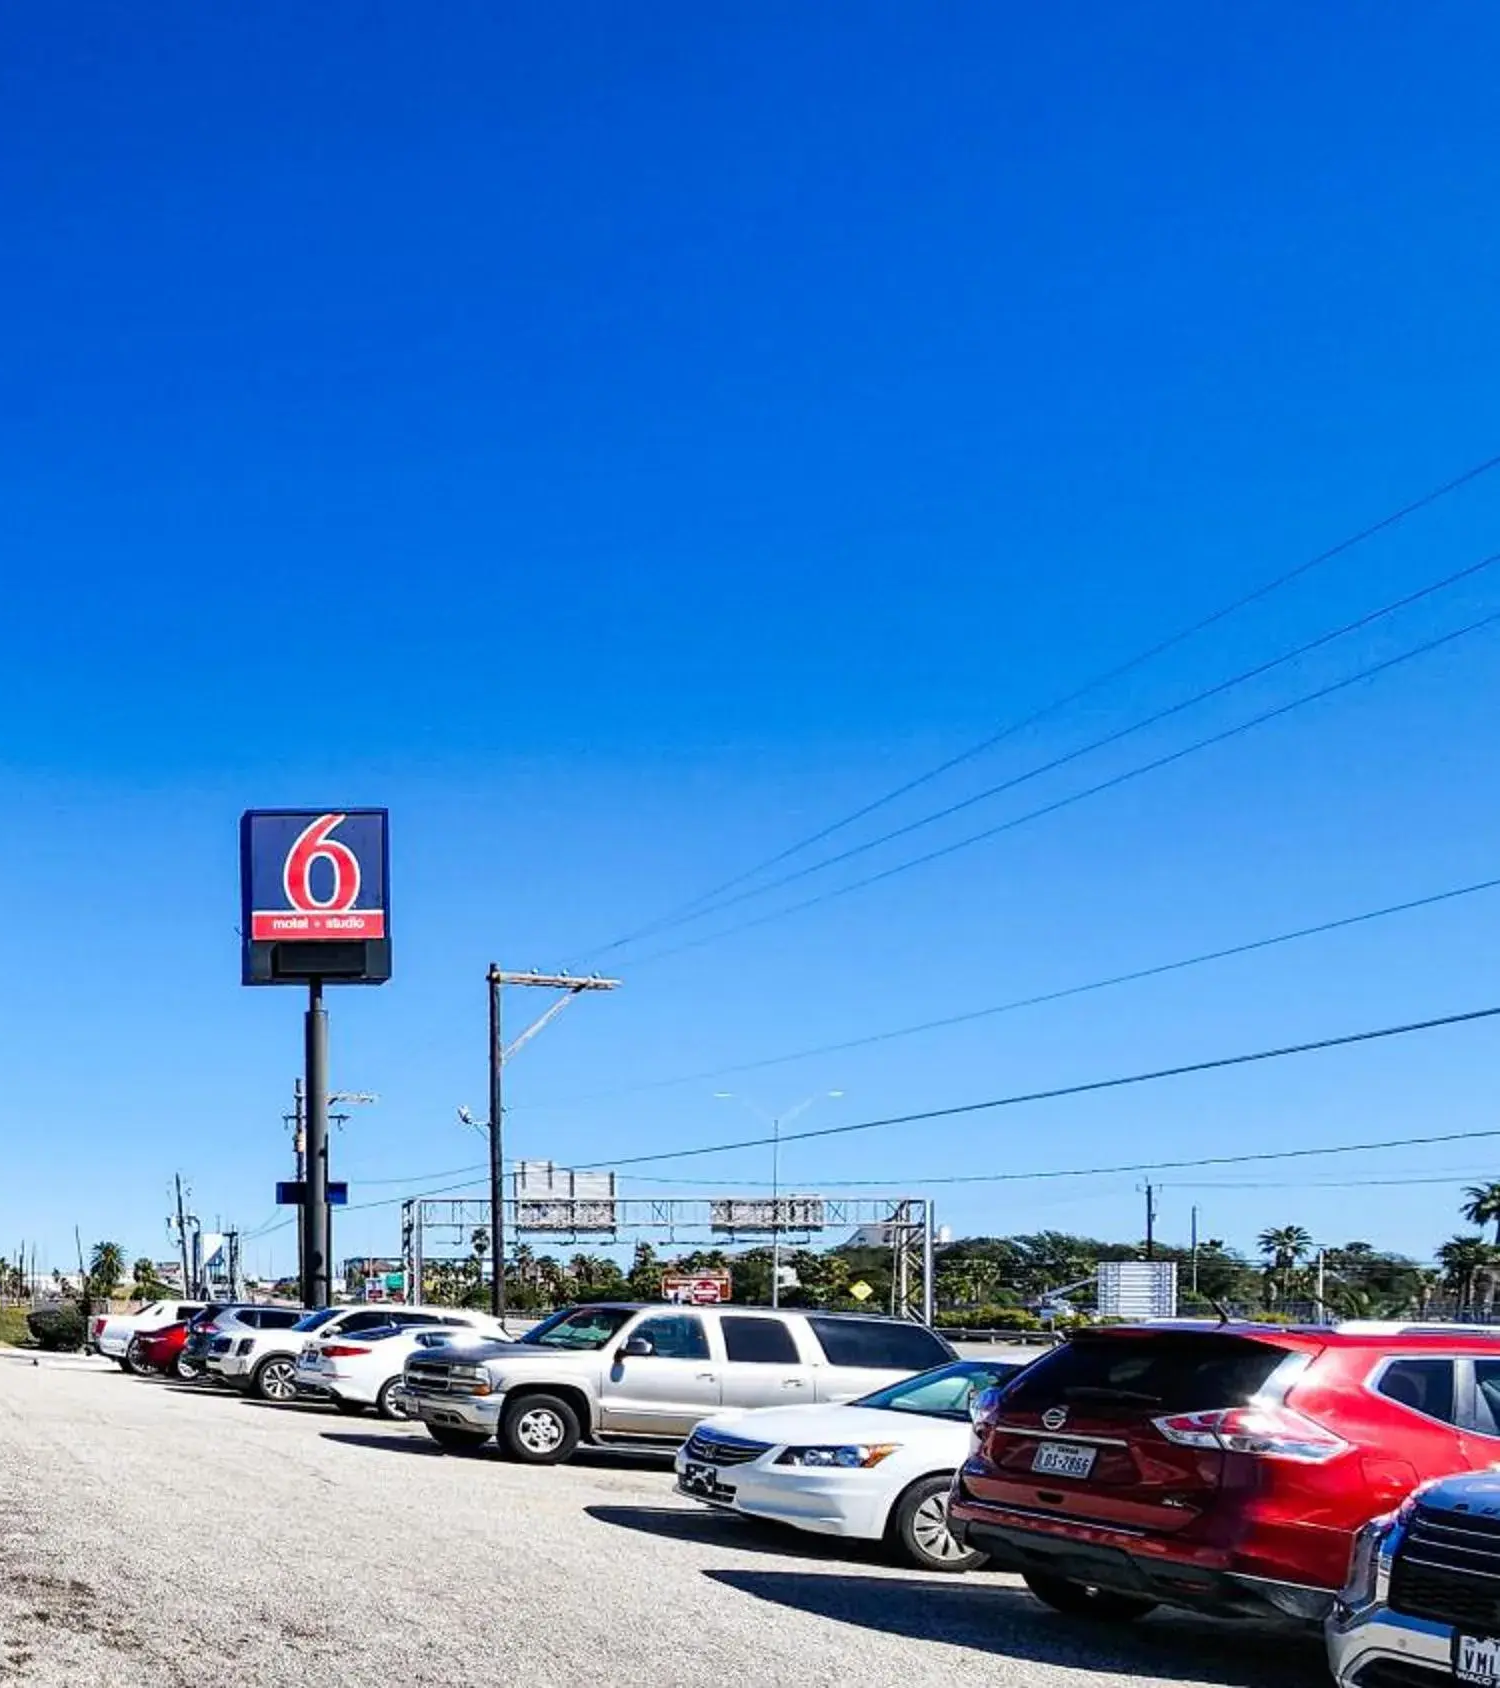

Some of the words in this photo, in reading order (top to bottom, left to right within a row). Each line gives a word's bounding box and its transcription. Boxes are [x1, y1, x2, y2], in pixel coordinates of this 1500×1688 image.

[283, 813, 361, 912] 6
[273, 917, 309, 929] motel
[325, 916, 365, 929] studio
